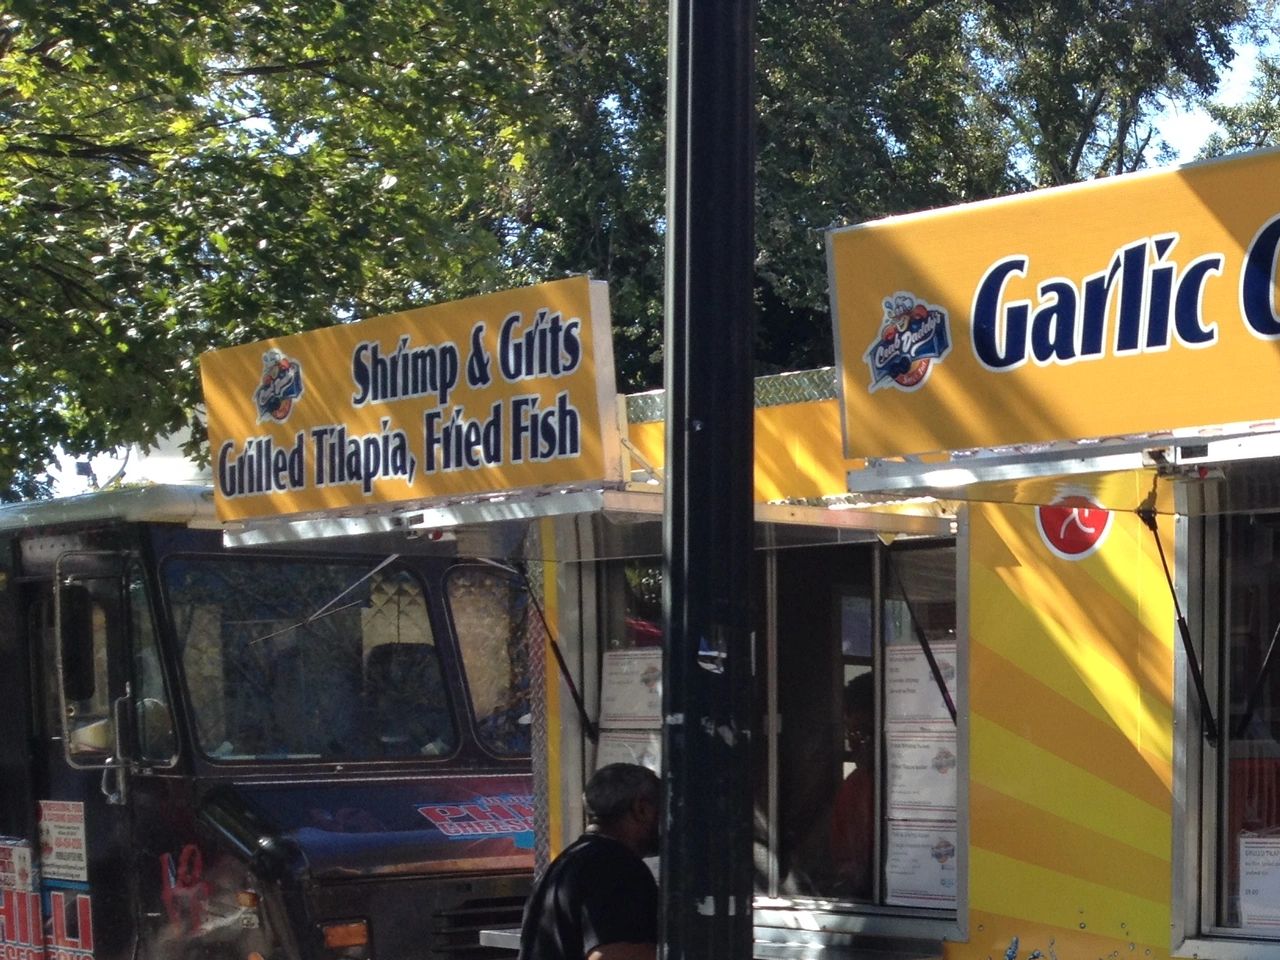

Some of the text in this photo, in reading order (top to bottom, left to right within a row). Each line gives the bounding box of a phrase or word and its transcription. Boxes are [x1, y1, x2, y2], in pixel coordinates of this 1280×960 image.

[973, 235, 1222, 370] Garlic
[352, 335, 458, 408] Shrimp
[467, 321, 491, 389] &
[498, 306, 580, 383] Grits
[218, 391, 581, 499] Grilled Tilapia, Fried Fish
